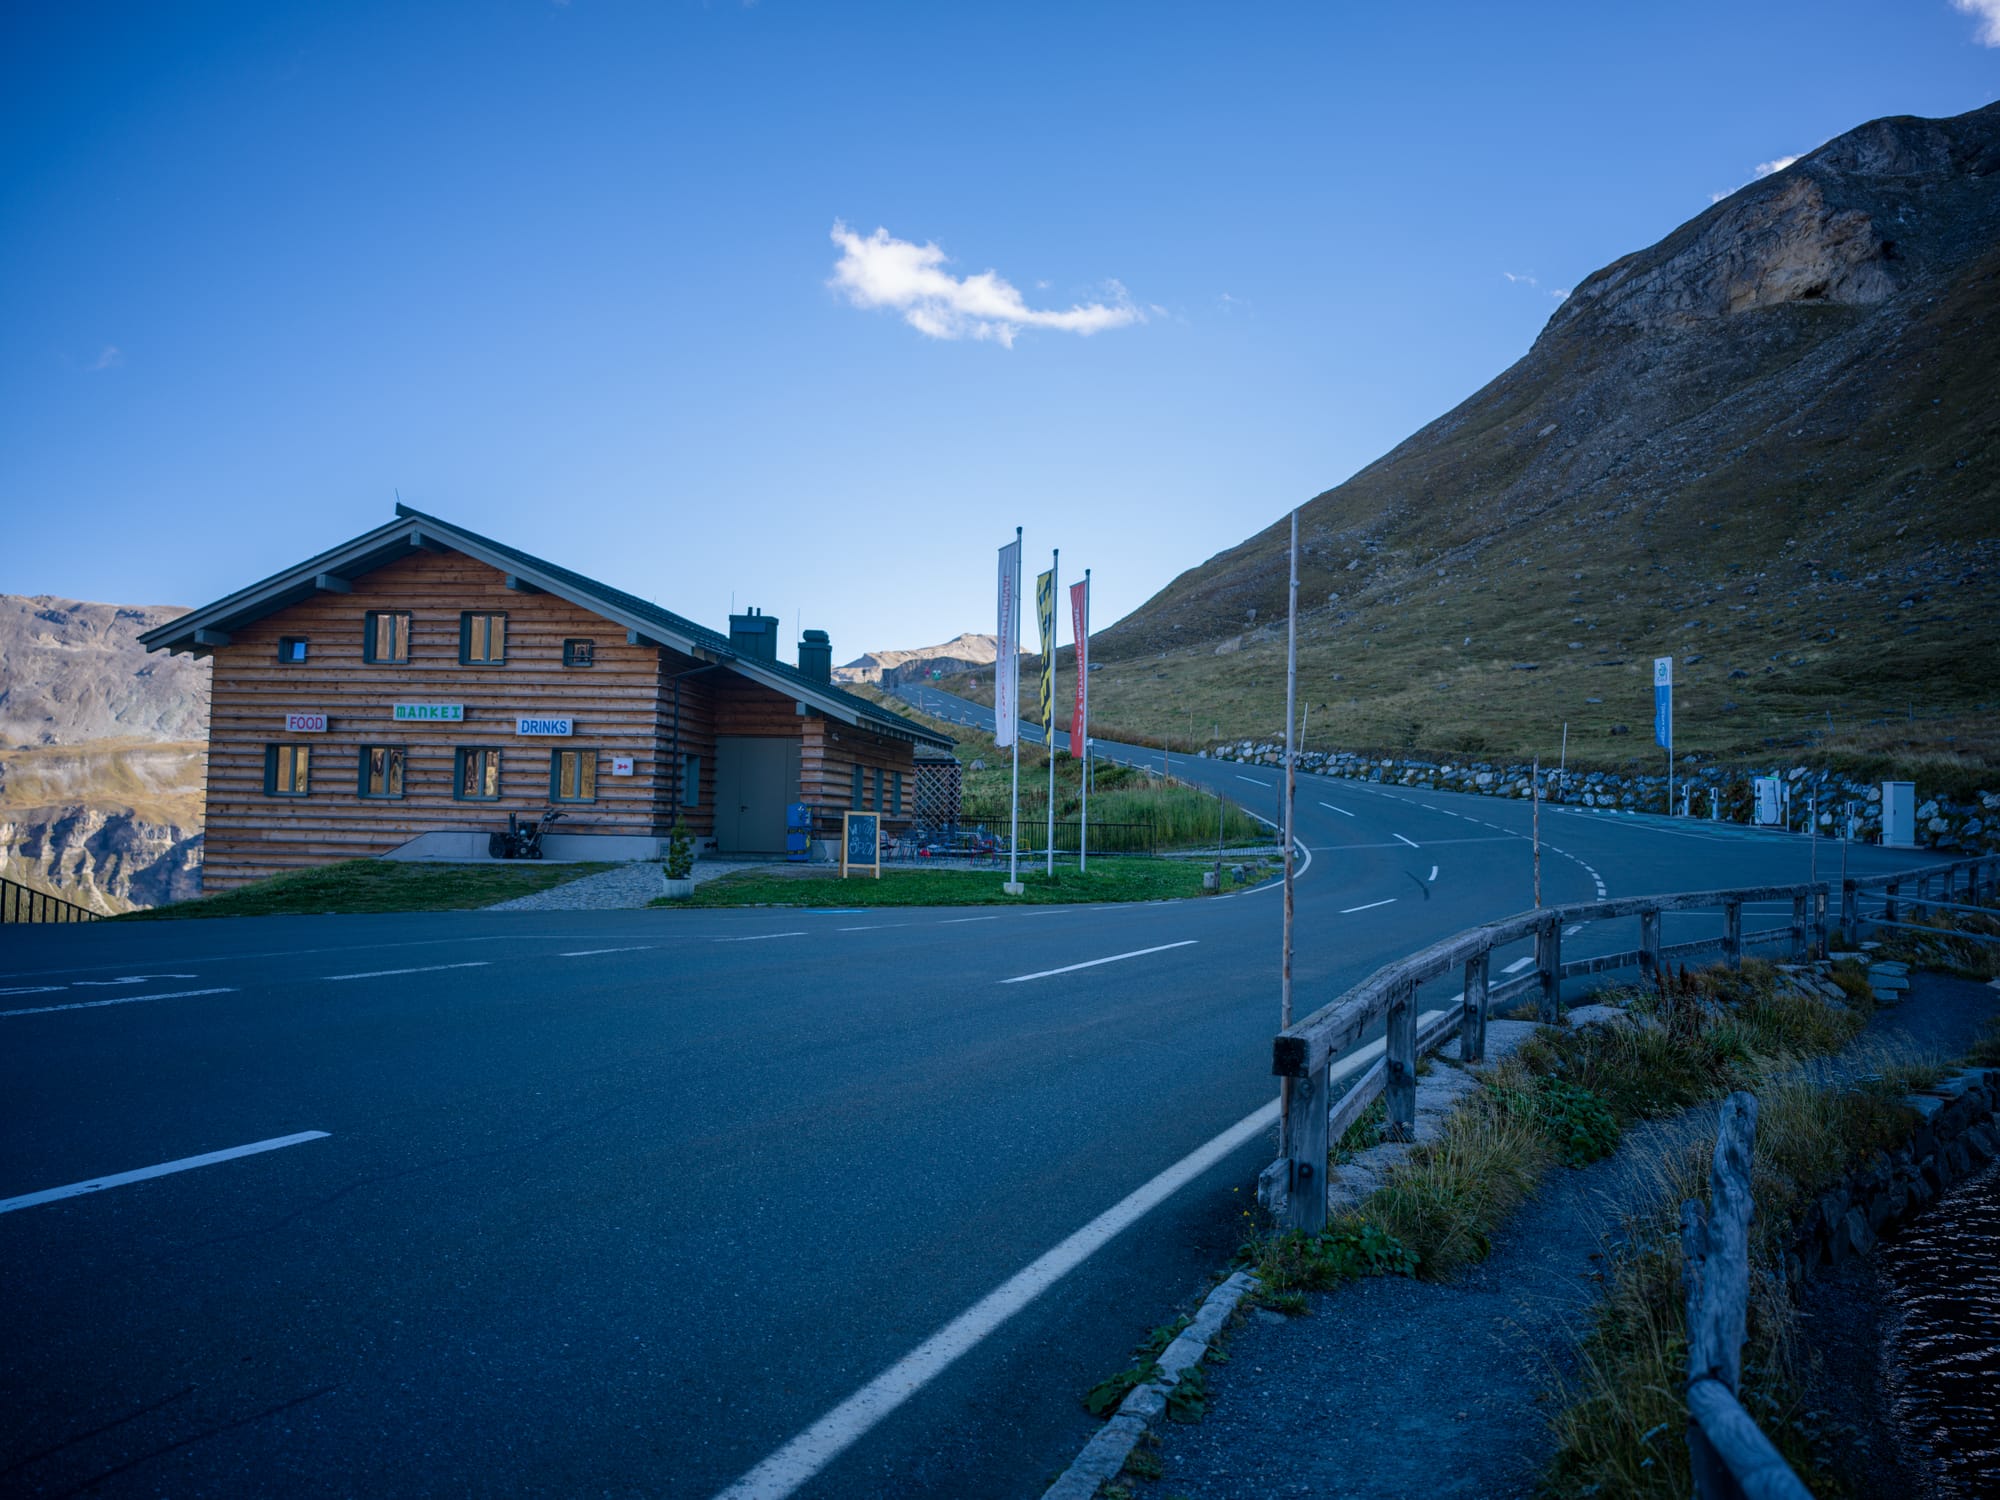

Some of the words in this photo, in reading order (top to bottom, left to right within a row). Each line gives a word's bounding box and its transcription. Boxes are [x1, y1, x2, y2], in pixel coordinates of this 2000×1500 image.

[396, 704, 461, 719] MANKEI
[289, 716, 323, 730] FOOD
[521, 719, 568, 734] DRINKS
